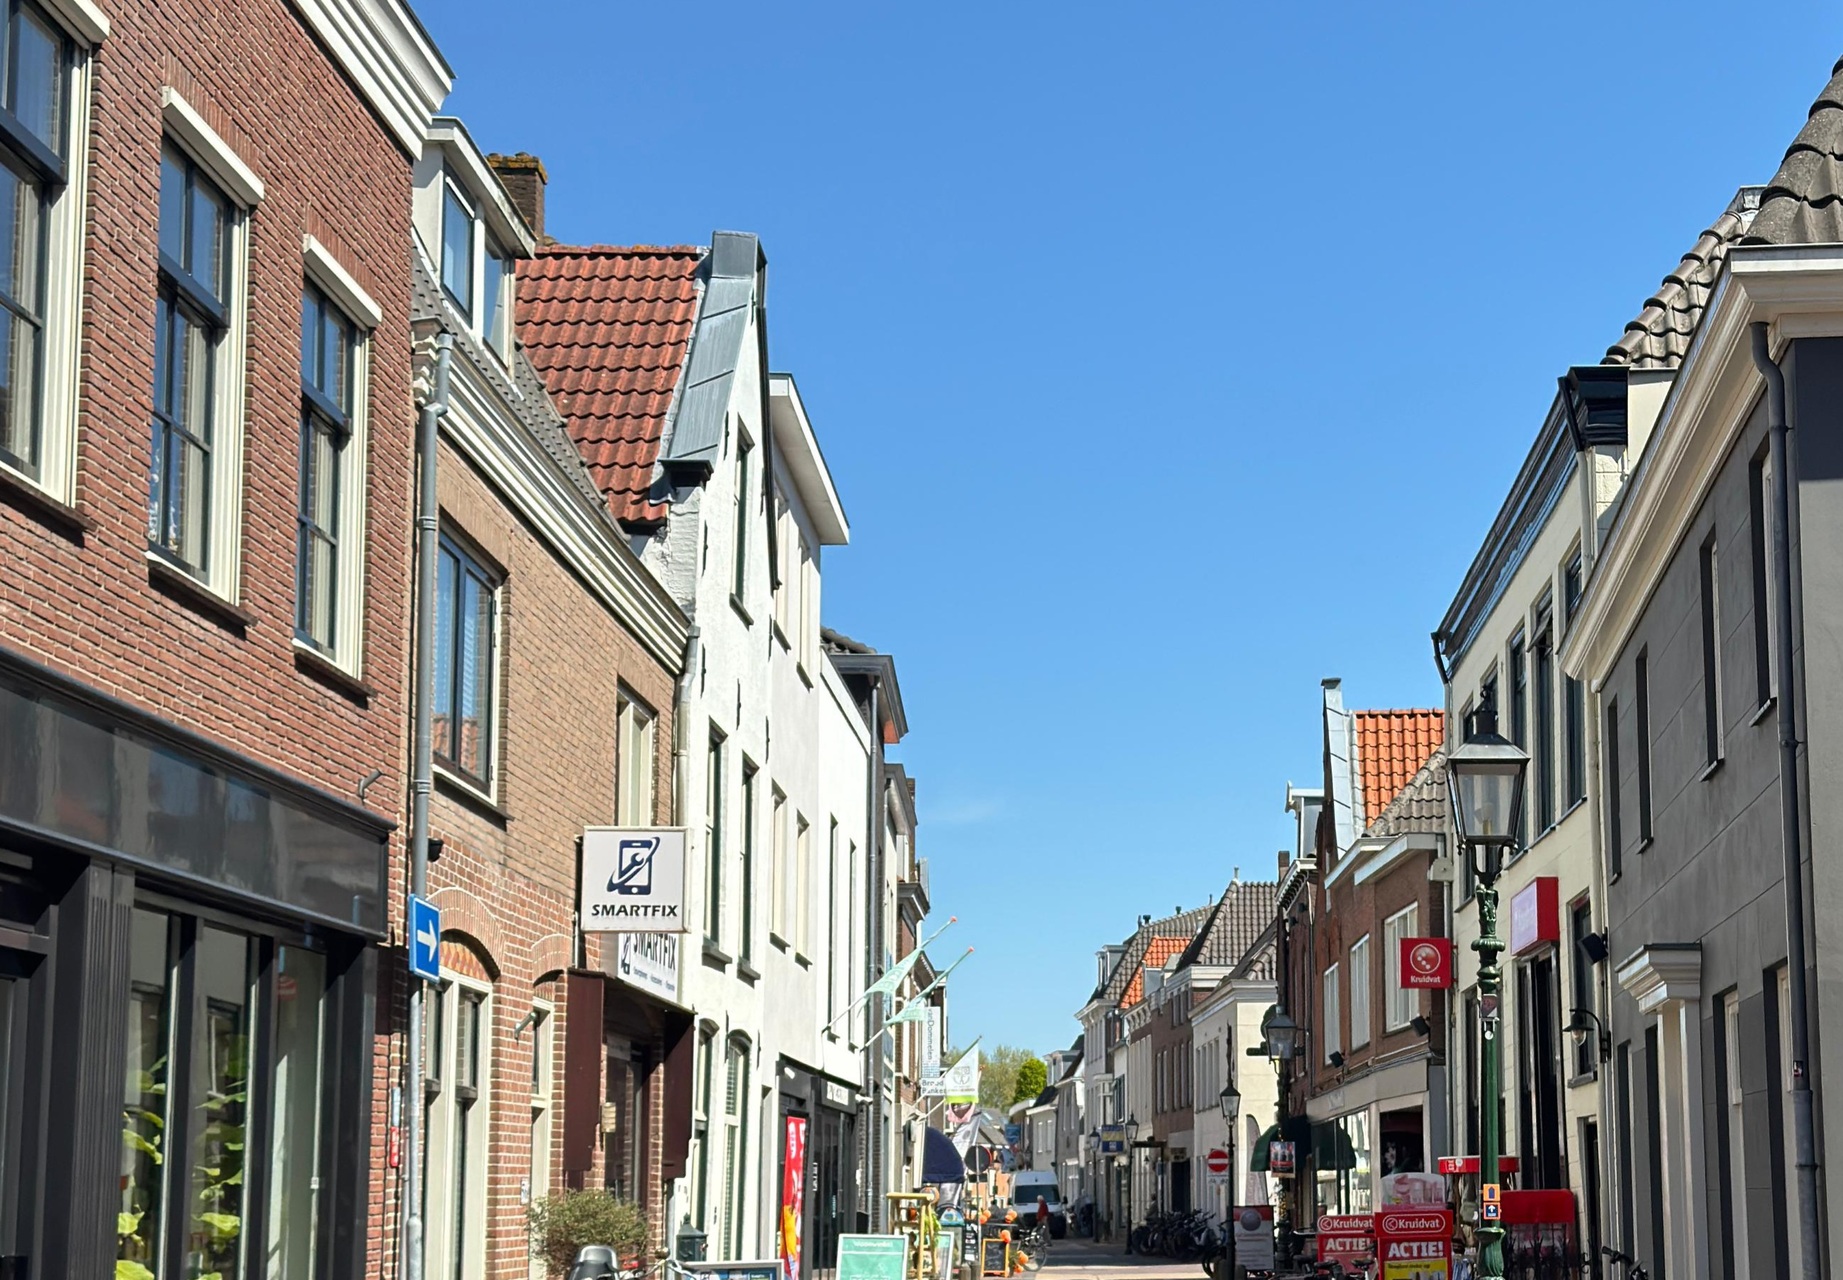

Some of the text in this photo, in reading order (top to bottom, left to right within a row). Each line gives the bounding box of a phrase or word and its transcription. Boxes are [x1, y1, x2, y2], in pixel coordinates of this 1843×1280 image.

[591, 904, 678, 917] SMARTFIX
[1410, 975, 1441, 983] Kruidvat
[1333, 1217, 1373, 1229] Kruidvat
[1399, 1218, 1440, 1229] Kruidvat
[1325, 1238, 1370, 1251] ACTIE!
[1388, 1241, 1444, 1257] ACTIE!
